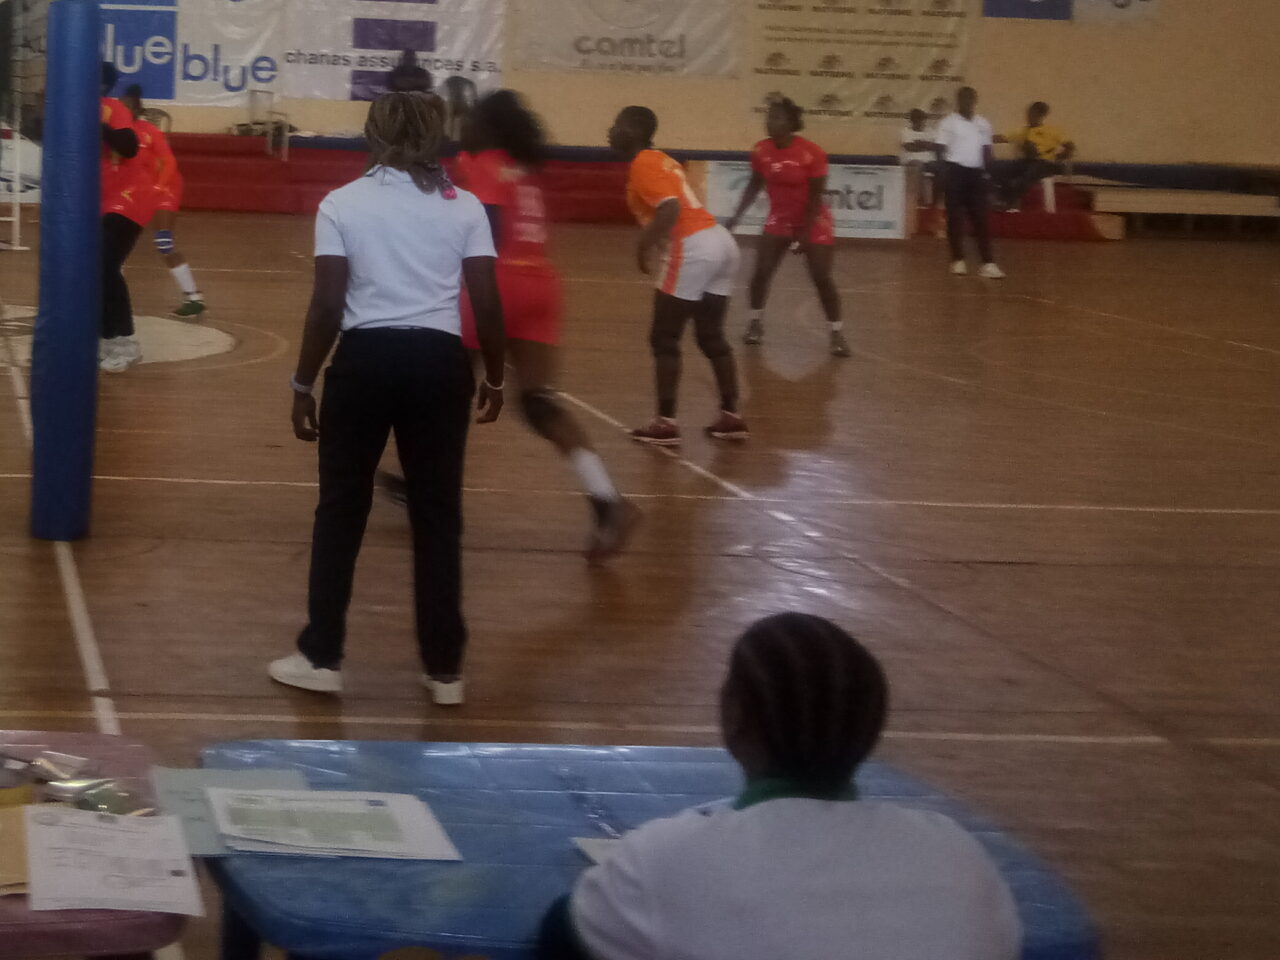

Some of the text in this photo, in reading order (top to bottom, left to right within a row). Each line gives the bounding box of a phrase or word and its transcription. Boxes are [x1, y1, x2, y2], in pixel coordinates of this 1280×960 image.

[285, 49, 352, 67] chanas
[573, 32, 687, 59] camtel
[182, 42, 278, 93] blue
